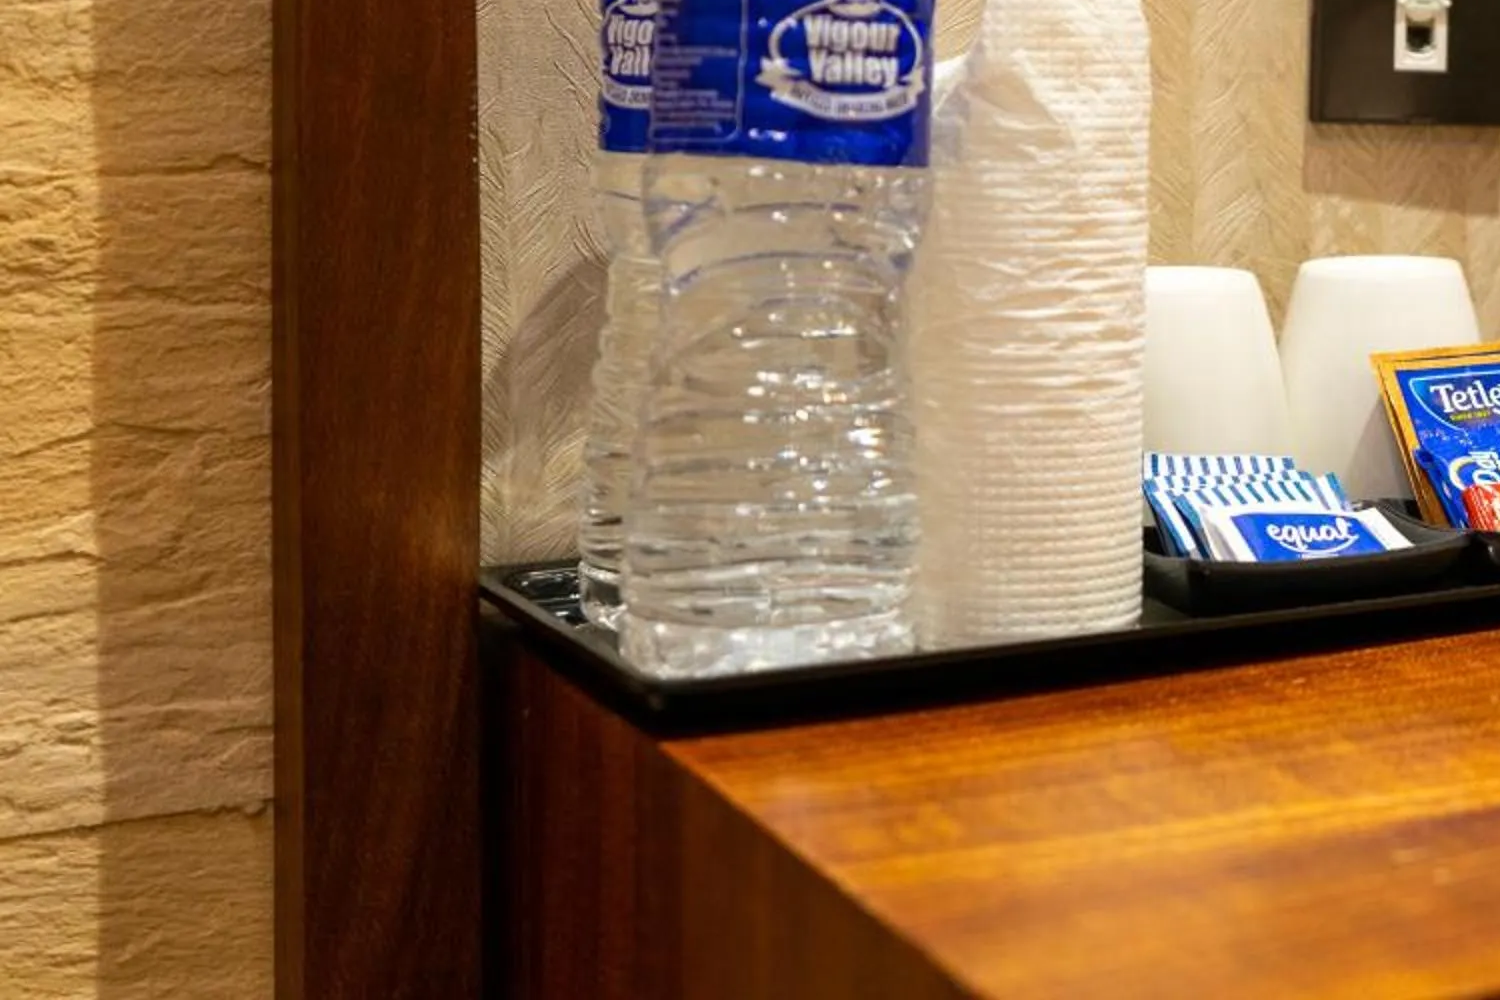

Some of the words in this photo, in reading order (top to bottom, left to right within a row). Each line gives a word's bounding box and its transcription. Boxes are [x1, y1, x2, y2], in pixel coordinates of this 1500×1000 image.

[607, 13, 655, 48] Vigo
[803, 14, 901, 51] Vigour
[808, 49, 899, 88] Valley
[1265, 516, 1356, 550] equal
